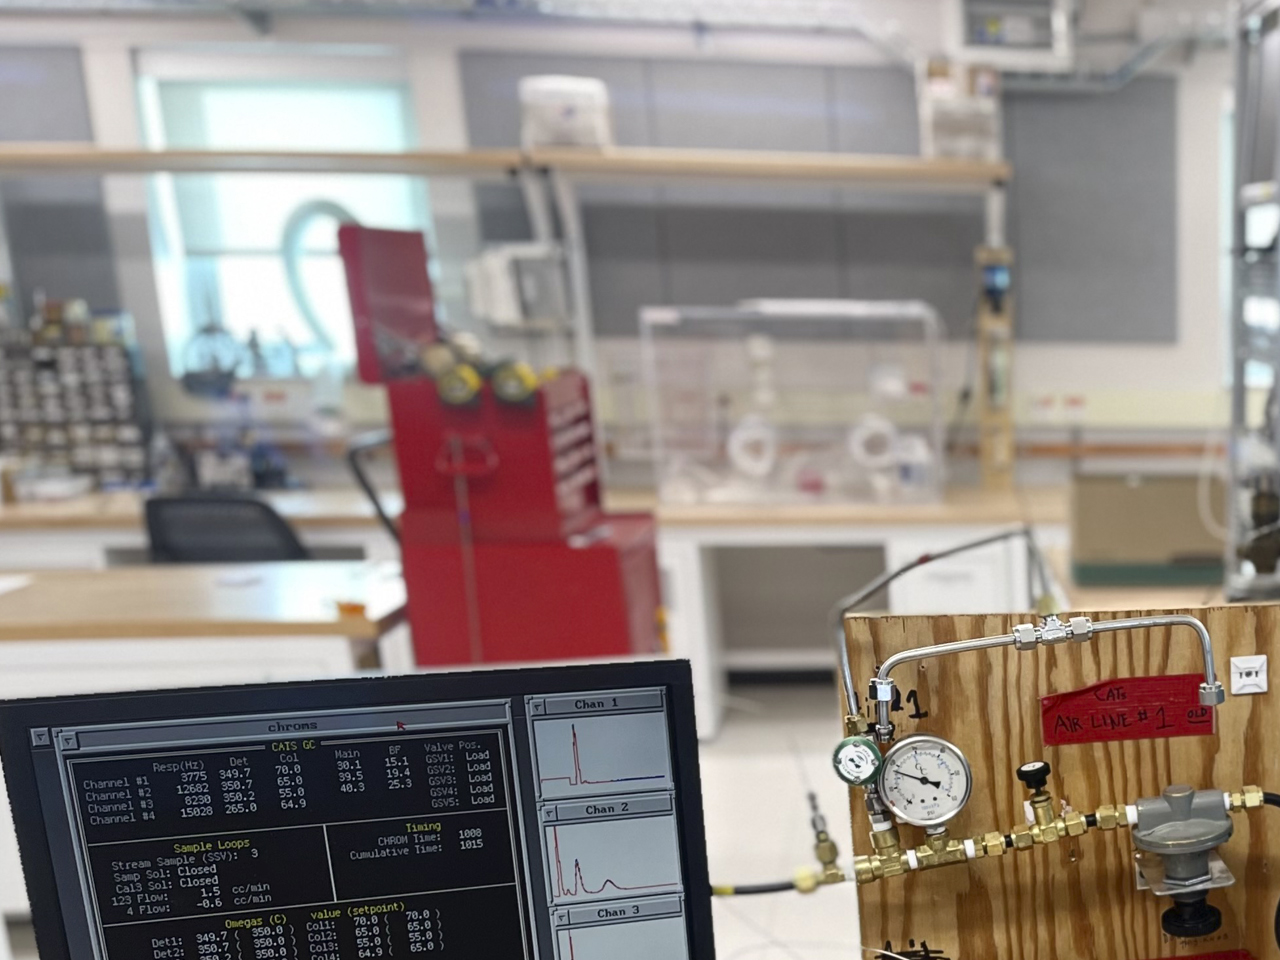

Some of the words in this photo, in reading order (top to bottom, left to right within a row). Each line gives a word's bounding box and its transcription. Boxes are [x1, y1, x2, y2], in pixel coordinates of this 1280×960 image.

[574, 699, 605, 710] Chan
[612, 698, 619, 707] 1
[267, 721, 318, 733] chroms
[1054, 714, 1083, 735] AIR
[1091, 711, 1133, 730] LINE
[1137, 710, 1148, 723] #
[1156, 706, 1175, 730] 1
[1187, 707, 1208, 719] OLD
[302, 740, 316, 750] GC
[153, 759, 205, 773] Resp(Hz)
[229, 756, 249, 767] Det
[279, 753, 299, 763] Col
[335, 749, 361, 759] Main
[389, 745, 401, 755] BF
[424, 741, 454, 753] Valve
[459, 740, 481, 750] Pos.
[83, 776, 130, 790] Channel
[136, 776, 150, 786] #1
[181, 771, 208, 782] 3775
[219, 767, 251, 779] 349.7
[275, 764, 301, 775] 70.0
[336, 760, 362, 771] 30.1
[384, 756, 409, 767] 15.1
[425, 752, 455, 764] GSV1:
[465, 750, 490, 761] Load
[585, 804, 616, 815] Chan
[621, 803, 629, 812] 2
[406, 822, 442, 834] Timing
[173, 841, 213, 855] Sample
[218, 839, 250, 850] Loops
[377, 835, 408, 847] CHROM
[413, 832, 441, 843] Time:
[350, 847, 410, 861] Cumulative
[415, 844, 442, 854] Time:
[460, 839, 484, 850] 1015
[111, 859, 151, 871] Stream
[156, 855, 196, 868] Sample
[251, 848, 259, 858] 3
[113, 871, 141, 883] Samp
[146, 869, 171, 880] Sol:
[177, 864, 217, 876] Closed
[225, 917, 263, 929] Omegas
[269, 913, 287, 925] (C)
[310, 908, 341, 920] value
[347, 901, 405, 917] (setpoint)
[597, 907, 627, 918] Chan
[632, 905, 640, 915] 3
